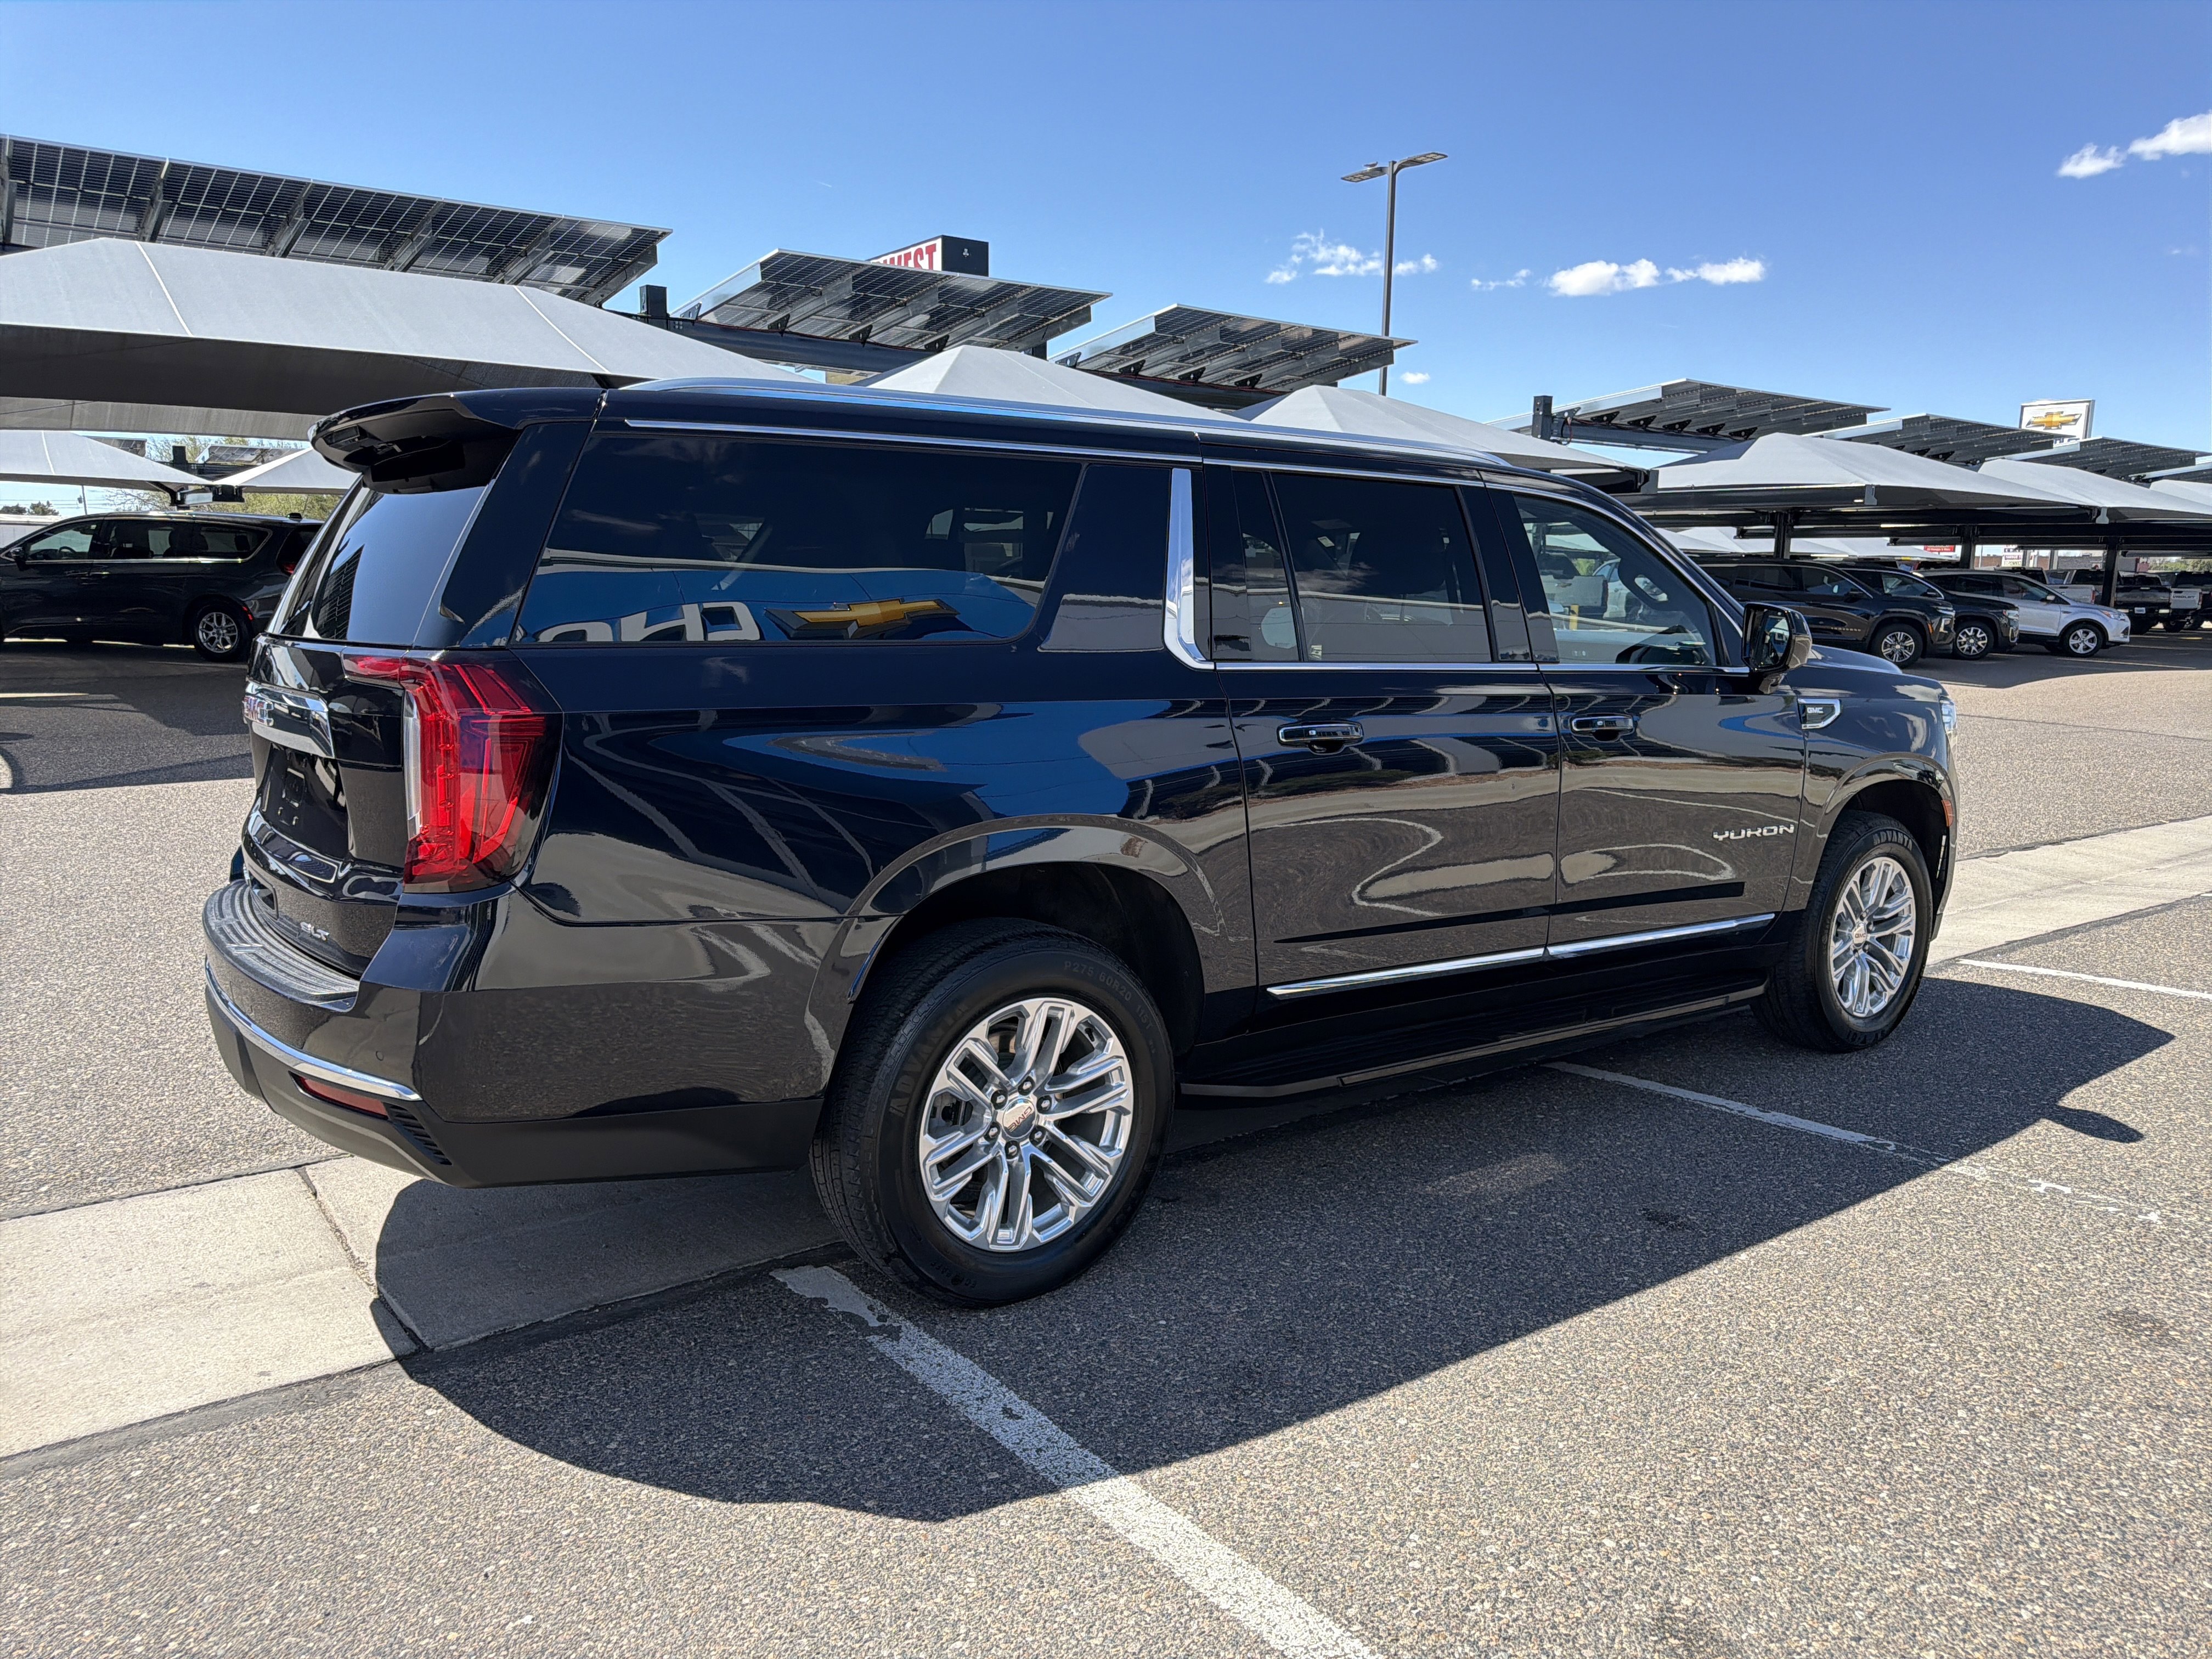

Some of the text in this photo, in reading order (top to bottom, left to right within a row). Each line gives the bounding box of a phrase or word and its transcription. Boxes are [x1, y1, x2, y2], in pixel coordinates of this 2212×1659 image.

[1713, 825, 1794, 840] YUKON
[1873, 830, 1912, 851] ADVANTA
[300, 922, 329, 941] SLT
[1008, 1106, 1032, 1132] GMC
